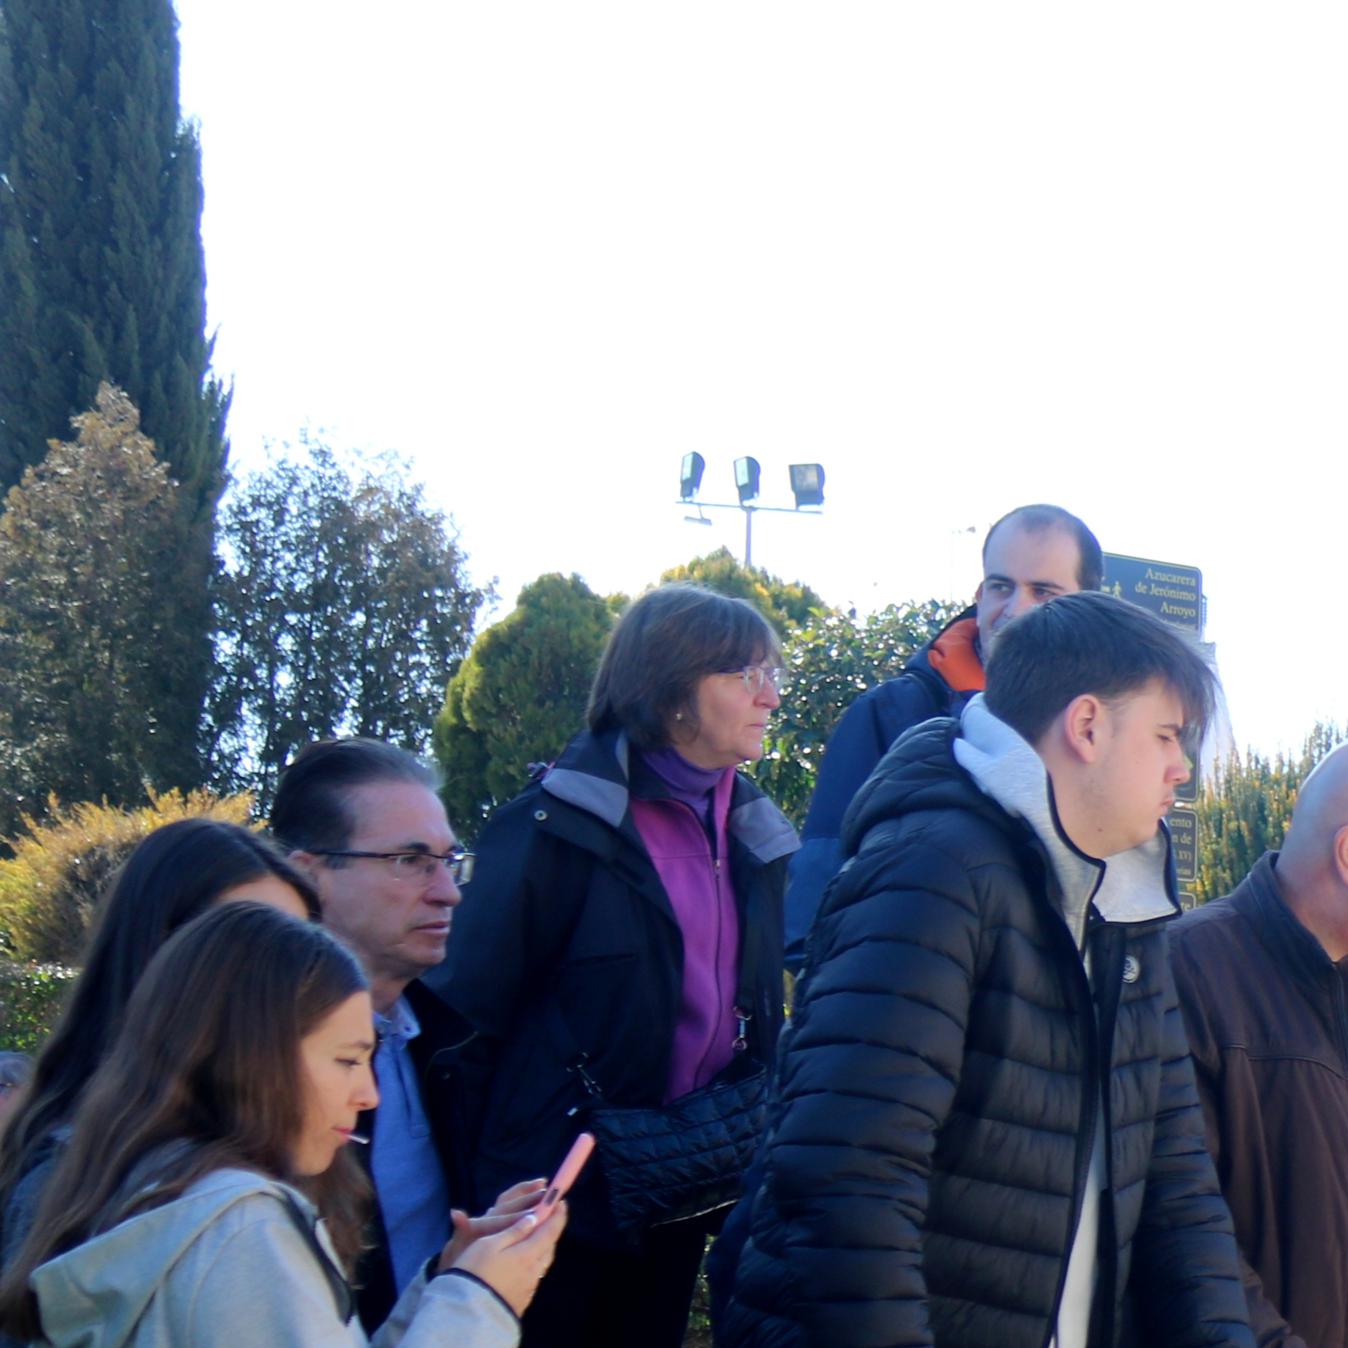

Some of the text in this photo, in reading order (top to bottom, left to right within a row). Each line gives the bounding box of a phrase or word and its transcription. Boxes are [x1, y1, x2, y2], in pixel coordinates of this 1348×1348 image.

[1145, 568, 1196, 586] Azucarera
[1135, 581, 1147, 594] de
[1160, 601, 1196, 618] Arroyo
[1170, 818, 1192, 828] ento
